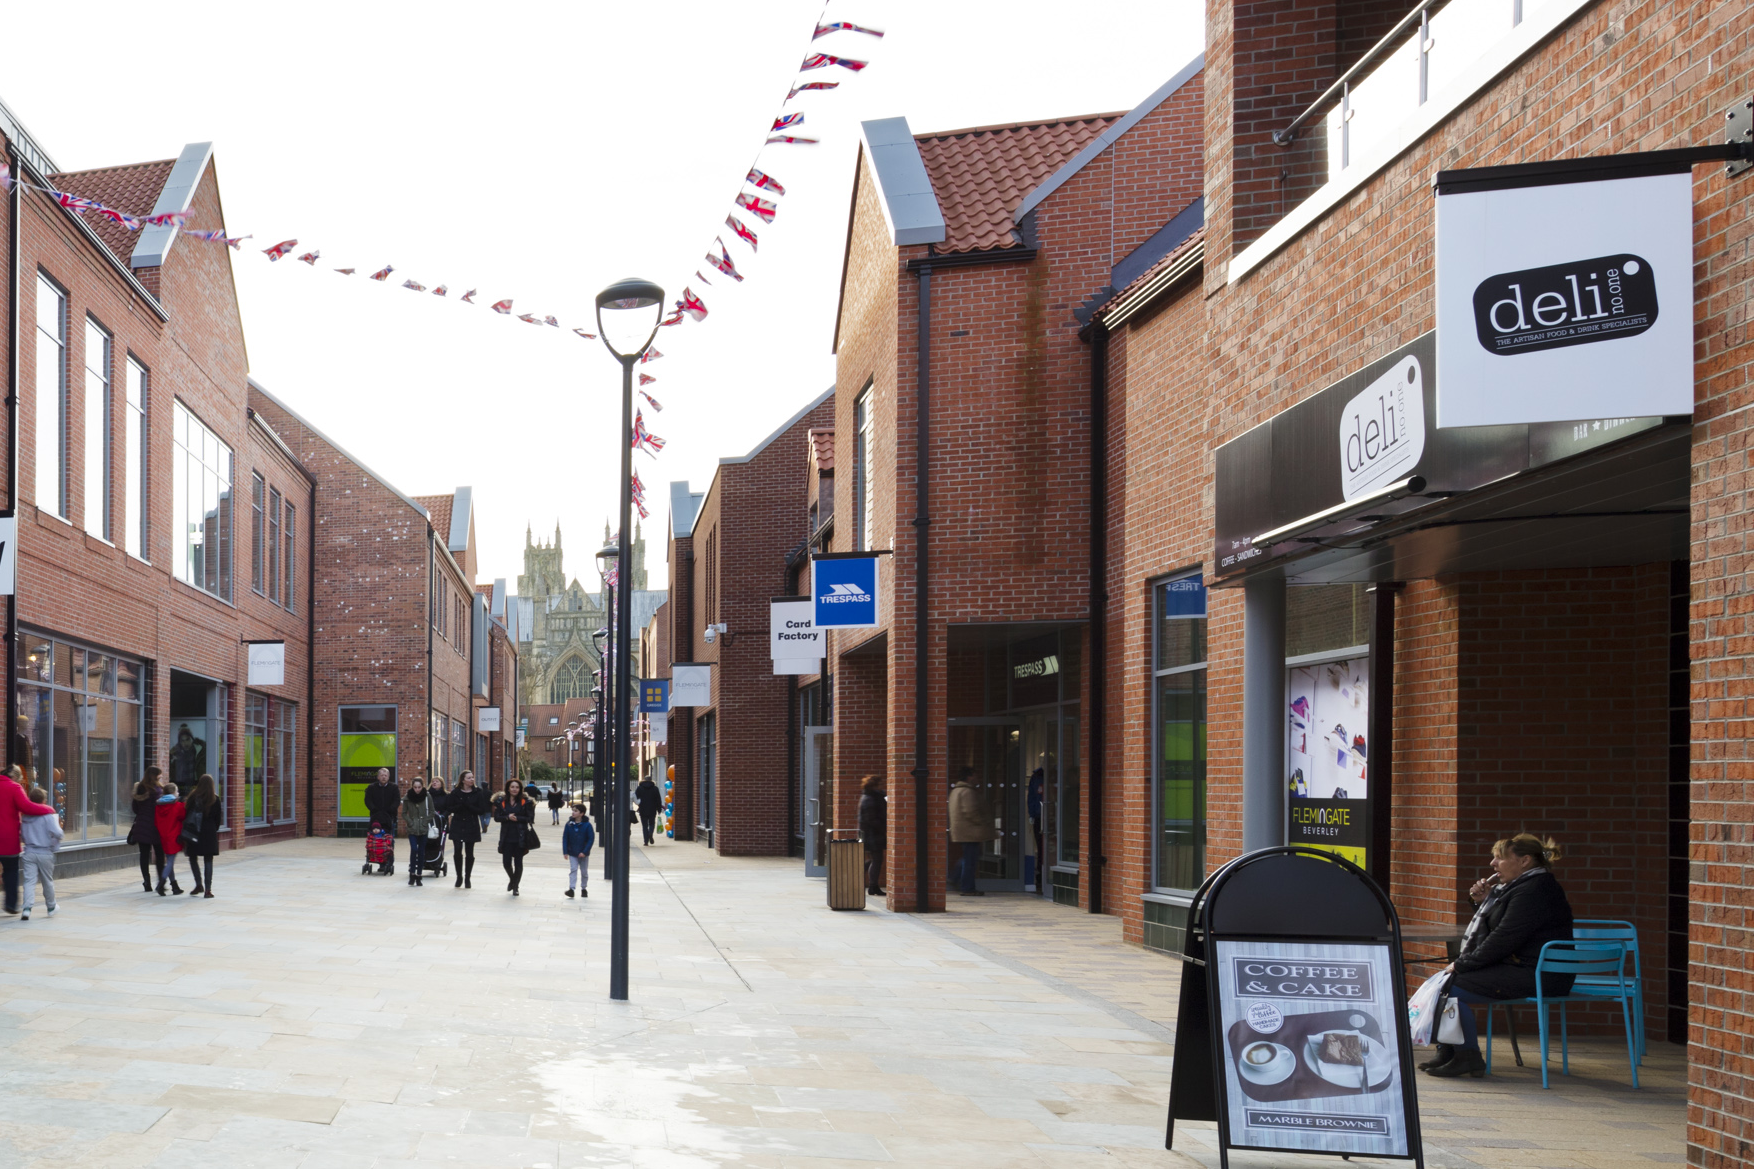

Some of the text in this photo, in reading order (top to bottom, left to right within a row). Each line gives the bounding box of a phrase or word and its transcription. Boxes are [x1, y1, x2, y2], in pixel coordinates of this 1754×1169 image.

[1606, 268, 1625, 315] no.one
[1489, 272, 1609, 333] deli
[1496, 337, 1512, 346] THE
[1513, 333, 1545, 344] ARTISAN
[1546, 329, 1567, 339] FOOD
[1577, 324, 1600, 333] DRINK
[1601, 317, 1648, 330] SPECIALISTS
[1397, 381, 1407, 439] no.one
[1346, 390, 1399, 473] deli
[1221, 554, 1235, 568] COFFEE
[1236, 547, 1262, 562] SANDWICHES
[820, 594, 871, 604] TRESPASS
[785, 620, 811, 629] Card
[777, 631, 819, 641] Factory
[1013, 660, 1043, 678] TRESPASS
[1292, 807, 1350, 825] FLEMINGATE
[1302, 826, 1339, 836] BEVERLEY
[1244, 964, 1359, 979] COFFEE
[1246, 981, 1363, 996] & CAKE
[1258, 1115, 1313, 1126] MARBLE
[1315, 1118, 1378, 1129] BROWNIE
